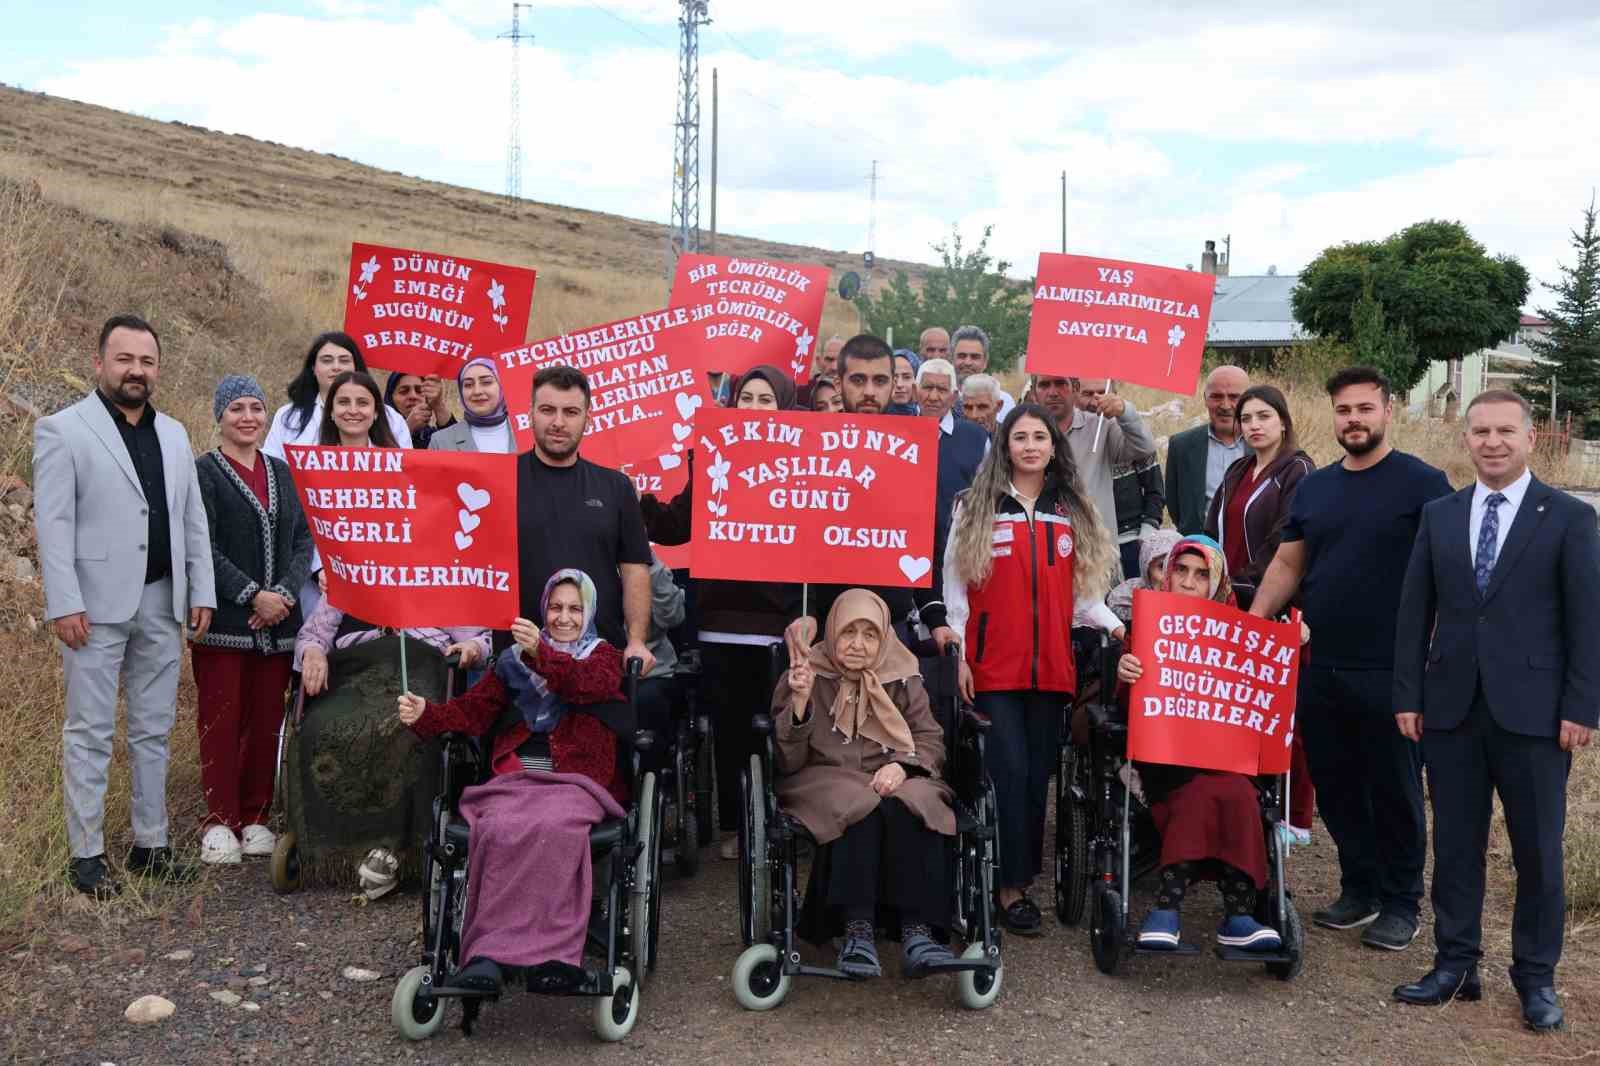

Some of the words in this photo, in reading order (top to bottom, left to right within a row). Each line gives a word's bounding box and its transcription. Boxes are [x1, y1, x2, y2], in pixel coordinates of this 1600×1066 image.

[392, 254, 473, 281] DÜNÜN
[688, 264, 718, 284] BİR
[727, 259, 811, 293] ÖMÜRLÜK
[1097, 267, 1134, 288] YAŞ
[393, 280, 466, 304] EMEĞİ
[706, 280, 787, 304] TECRÜBE
[1035, 286, 1201, 319] ALMIŞLARIMIZLA
[372, 302, 475, 331] BUGÜNÜN
[705, 320, 763, 342] DEĞER
[717, 297, 803, 336] ÖMÜRLÜK
[1057, 320, 1148, 344] SAYGIYLA
[363, 330, 473, 361] BEREKETİ
[500, 308, 689, 369] TECRÜBELERİYLE
[700, 434, 718, 454] 1
[719, 417, 803, 447] EKİM
[820, 423, 920, 464] DÜNYA
[290, 450, 403, 472] YARININ
[737, 456, 878, 490] YAŞLILAR
[305, 484, 417, 509] REHBERİ
[768, 480, 851, 511] GÜNÜ
[312, 515, 413, 543] DEĞERLİ
[707, 520, 797, 545] KUTLU
[823, 525, 908, 548] OLSUN
[327, 553, 510, 591] BÜYÜKLERİMİZ
[1158, 614, 1296, 666] GEÇMİŞİN
[1153, 638, 1292, 686] ÇINARLARI
[1159, 667, 1276, 710] BUGÜNÜN
[1143, 693, 1280, 736] DEĞERLERİ
